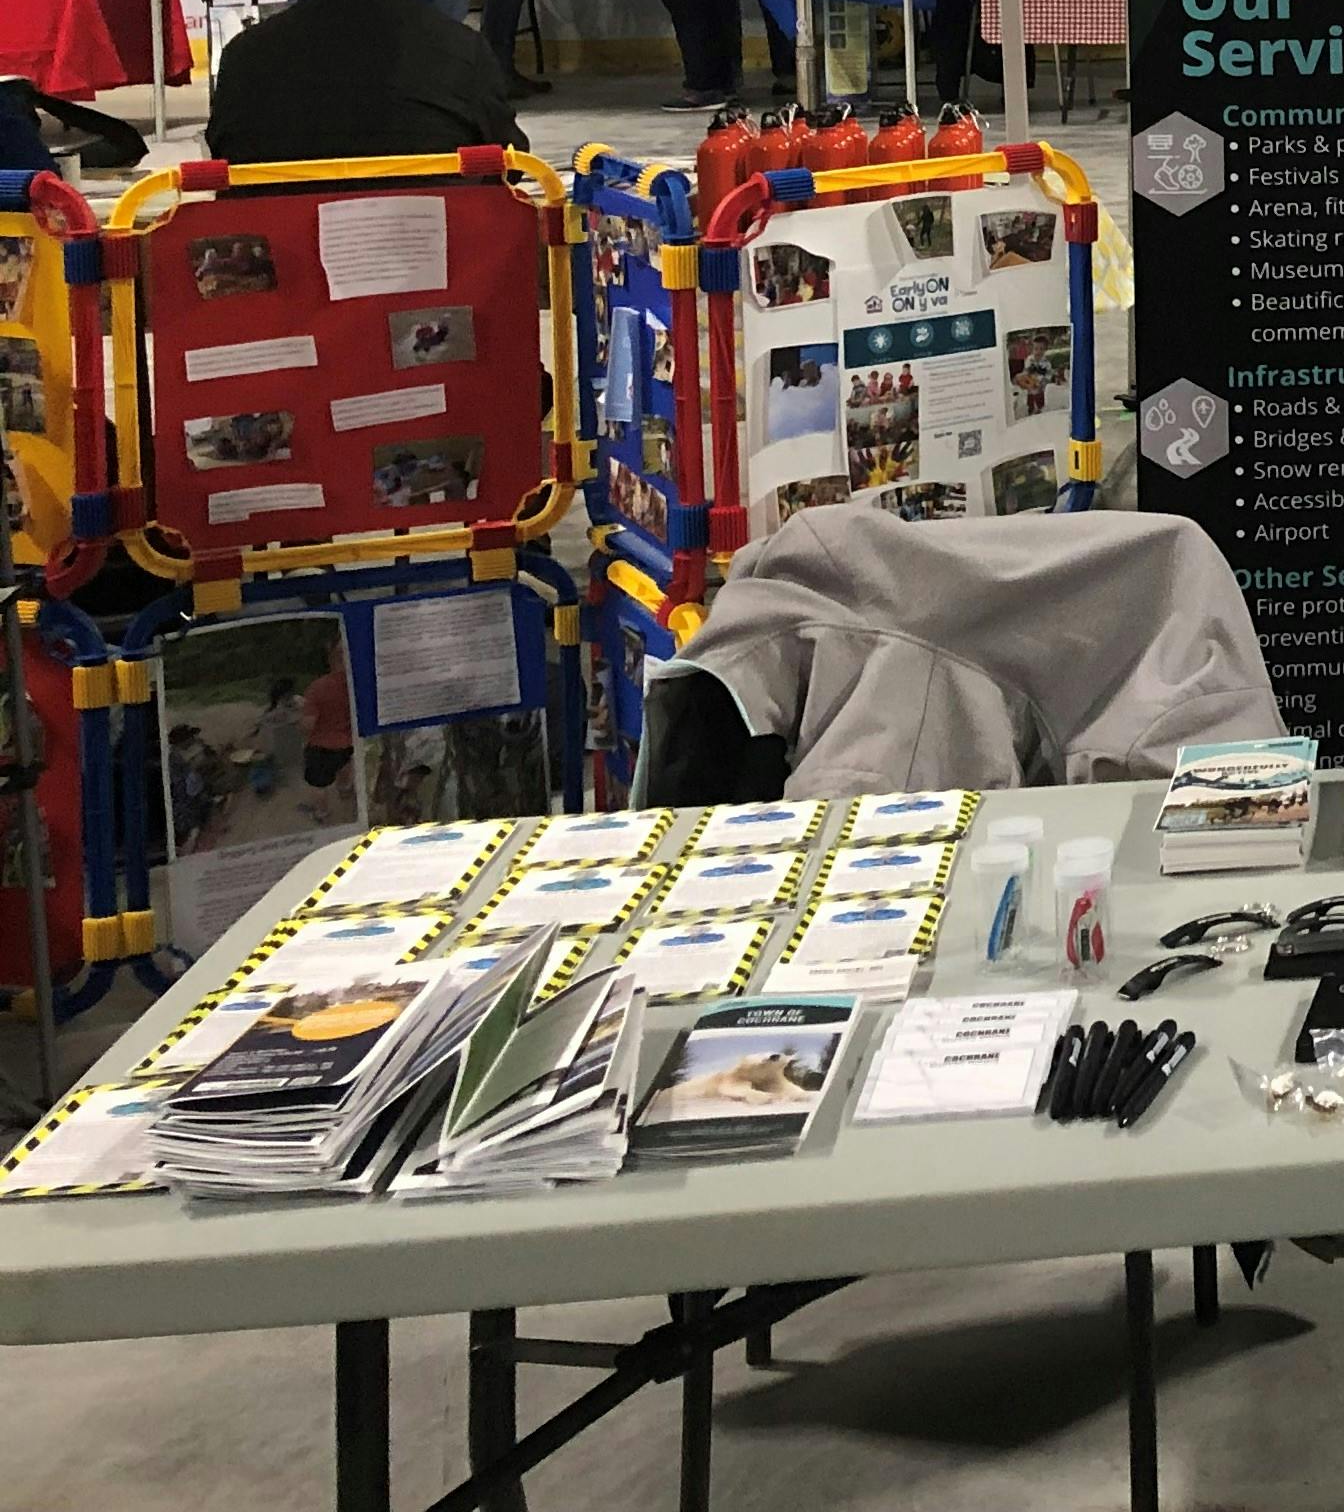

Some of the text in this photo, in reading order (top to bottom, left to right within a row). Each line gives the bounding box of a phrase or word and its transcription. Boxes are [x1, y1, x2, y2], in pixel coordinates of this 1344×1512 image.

[1248, 136, 1306, 154] Parks
[1249, 166, 1339, 185] Festivals
[890, 276, 949, 298] EarlyON
[1253, 397, 1318, 416] Roads
[736, 1014, 806, 1026] COCHRANE
[746, 1009, 782, 1018] TOWN
